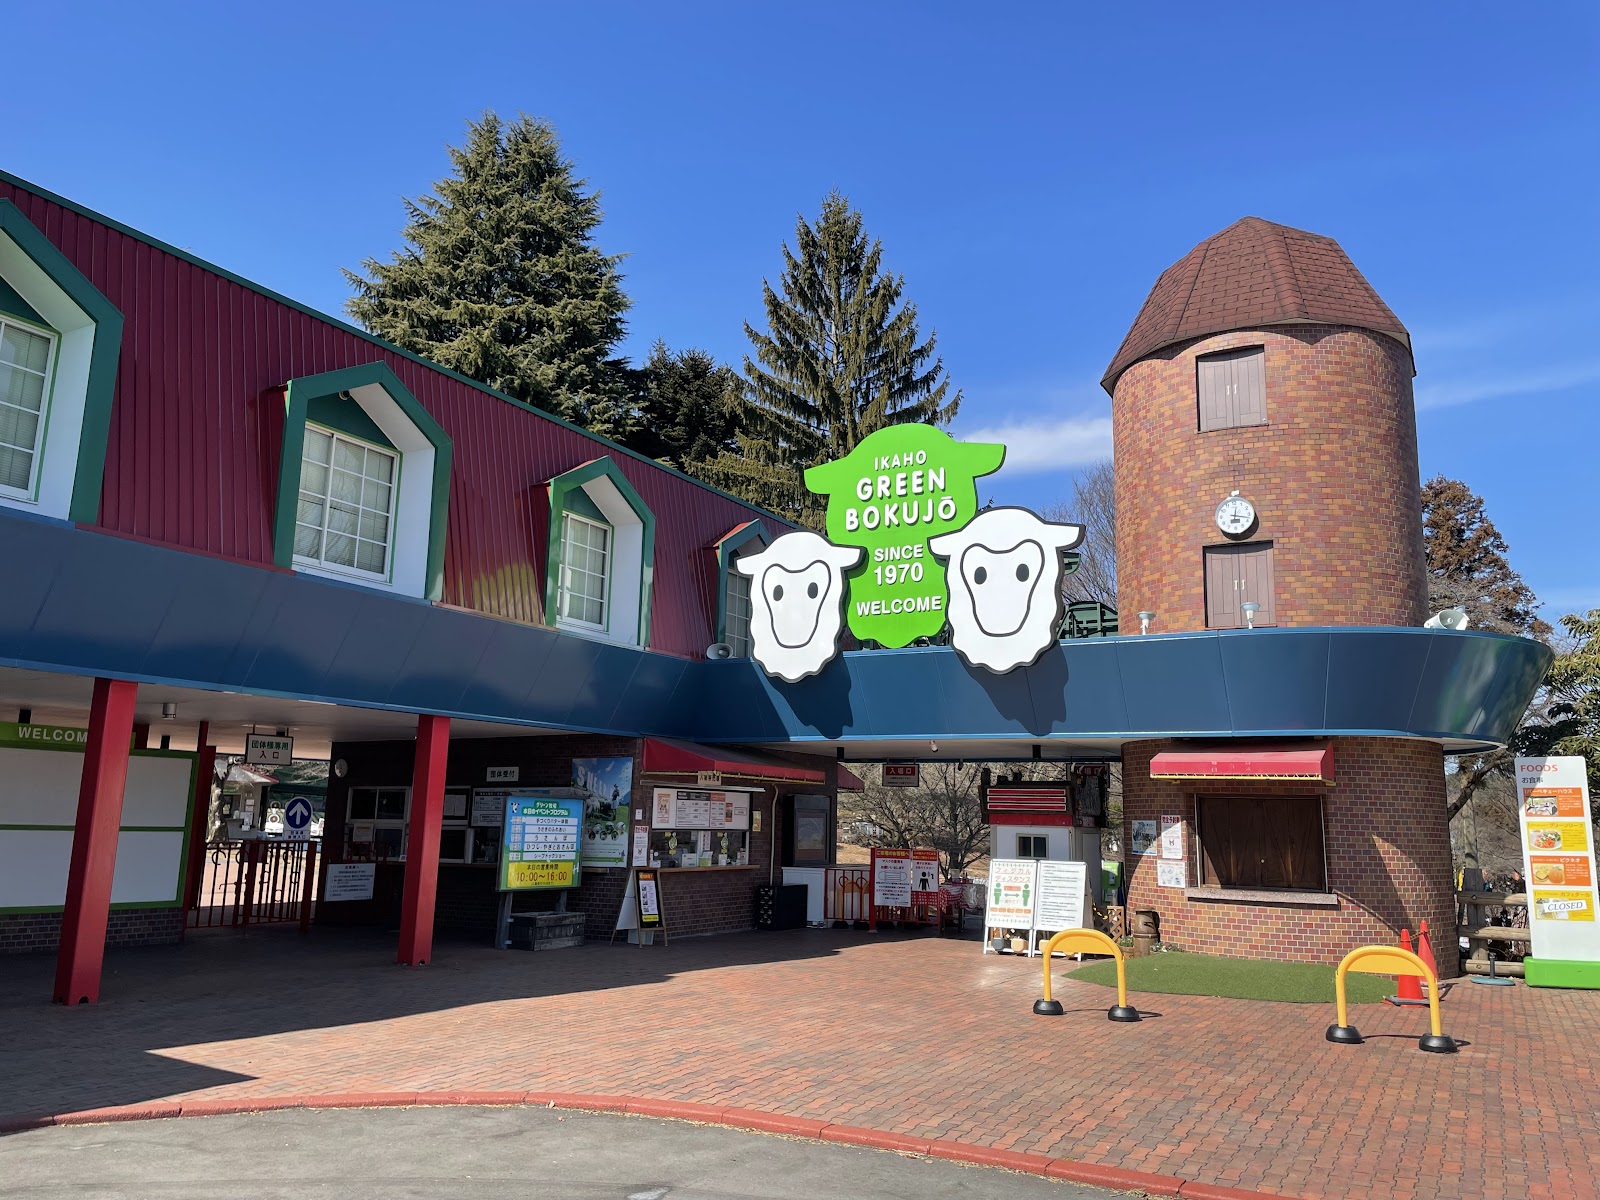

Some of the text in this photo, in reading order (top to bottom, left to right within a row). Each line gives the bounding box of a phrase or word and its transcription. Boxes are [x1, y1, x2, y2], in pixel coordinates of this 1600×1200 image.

[874, 450, 927, 470] IKAHO
[857, 467, 945, 501] GREEN
[846, 496, 956, 531] BOKUJŌ
[874, 544, 923, 562] SINCE
[874, 562, 923, 585] 1970
[856, 596, 942, 616] WELCOME
[18, 726, 88, 742] WELCOM
[252, 740, 289, 750] 団体様専用
[260, 751, 279, 759] 入口
[490, 770, 515, 778] 団体受付
[1548, 902, 1583, 911] CLOSED
